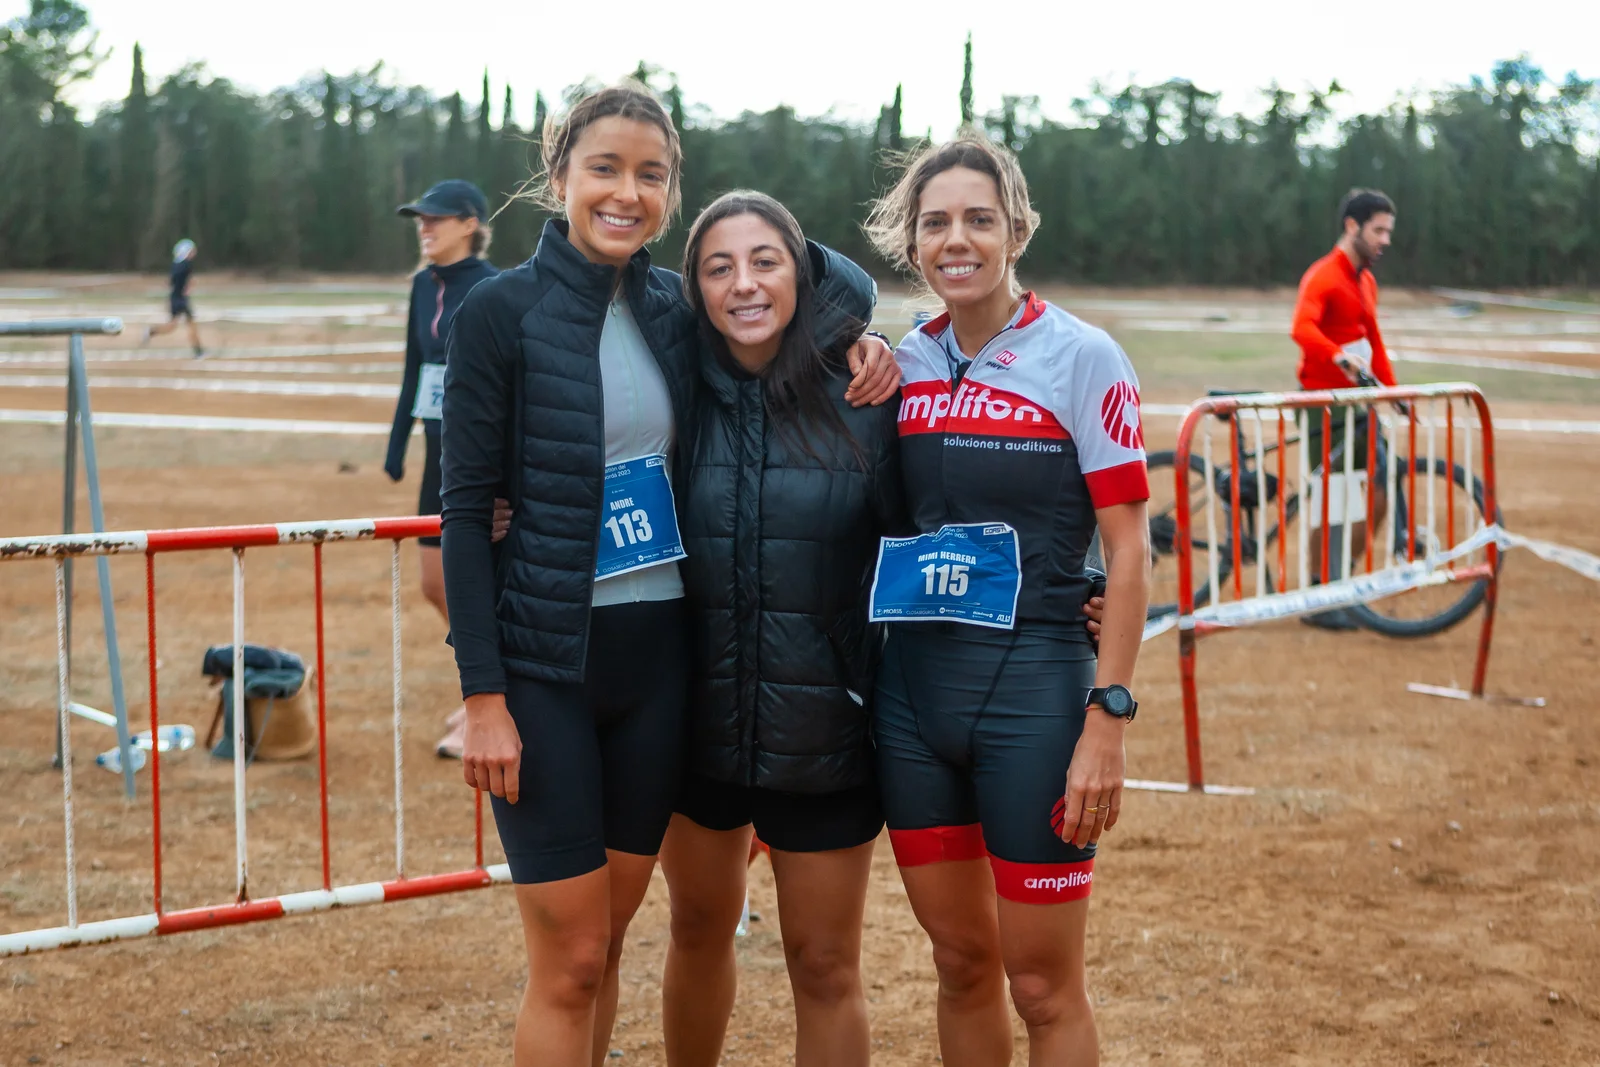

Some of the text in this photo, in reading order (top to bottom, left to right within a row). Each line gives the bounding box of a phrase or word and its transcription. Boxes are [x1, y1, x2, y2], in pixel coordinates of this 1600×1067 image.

[998, 352, 1014, 363] IN
[943, 436, 1062, 453] soluciones auditivas
[610, 497, 635, 511] ANDRE
[604, 509, 653, 549] 113
[918, 551, 977, 565] MIMI HERRERA
[921, 563, 970, 597] 115
[1024, 871, 1093, 892] amplifon
